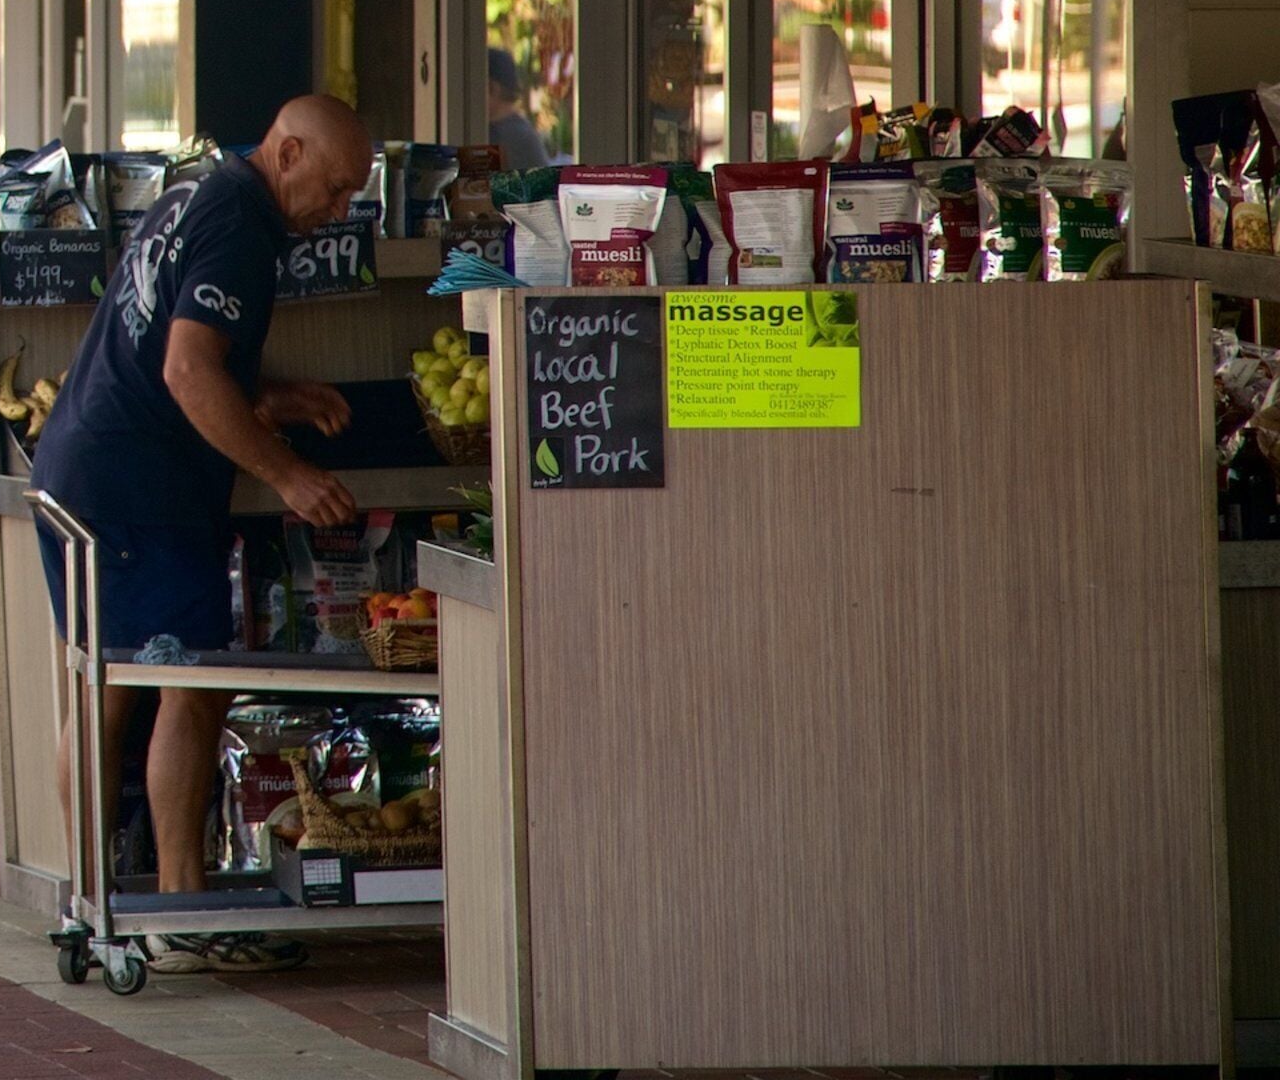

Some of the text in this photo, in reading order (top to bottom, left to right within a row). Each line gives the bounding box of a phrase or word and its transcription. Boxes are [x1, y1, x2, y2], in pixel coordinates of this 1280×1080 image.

[1, 238, 101, 260] Organic Bananas
[581, 245, 643, 262] muesli
[850, 241, 912, 257] muesli
[193, 283, 243, 321] QS
[671, 293, 737, 304] awesome
[669, 304, 804, 327] massage
[529, 306, 639, 347] Organic
[708, 326, 740, 336] tissue
[727, 339, 761, 349] Detox
[765, 339, 797, 349] Boost
[534, 341, 619, 384] Local
[732, 353, 793, 365] Alignment
[742, 366, 760, 377] hot
[764, 367, 793, 377] stone
[796, 367, 837, 380] therapy
[726, 380, 755, 393] point
[758, 380, 800, 394] therapy
[541, 386, 616, 431] Beef
[731, 409, 767, 418] blended
[769, 409, 807, 418] essential
[574, 434, 652, 476] Pork
